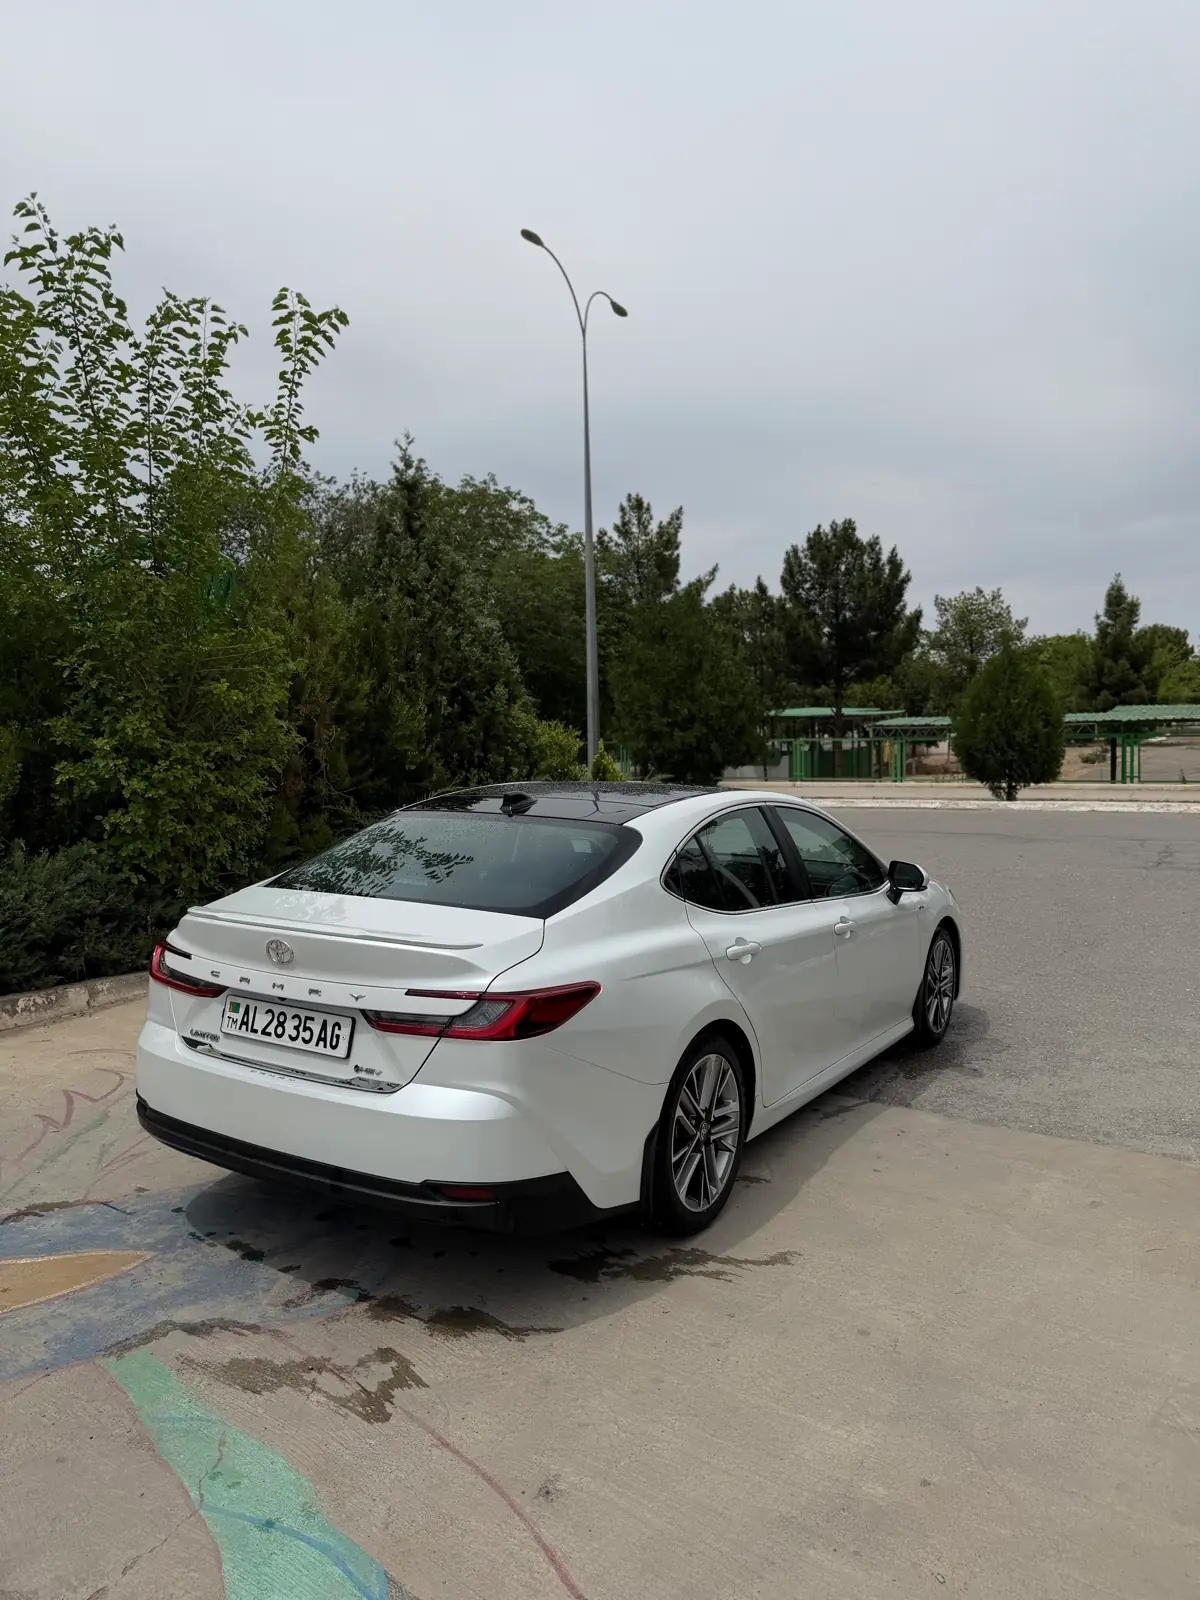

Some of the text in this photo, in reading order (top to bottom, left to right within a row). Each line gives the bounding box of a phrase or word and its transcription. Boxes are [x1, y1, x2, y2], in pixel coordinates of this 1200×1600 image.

[210, 970, 366, 1002] CAMRY
[226, 1015, 239, 1030] TM
[238, 1004, 342, 1050] AL2835AG
